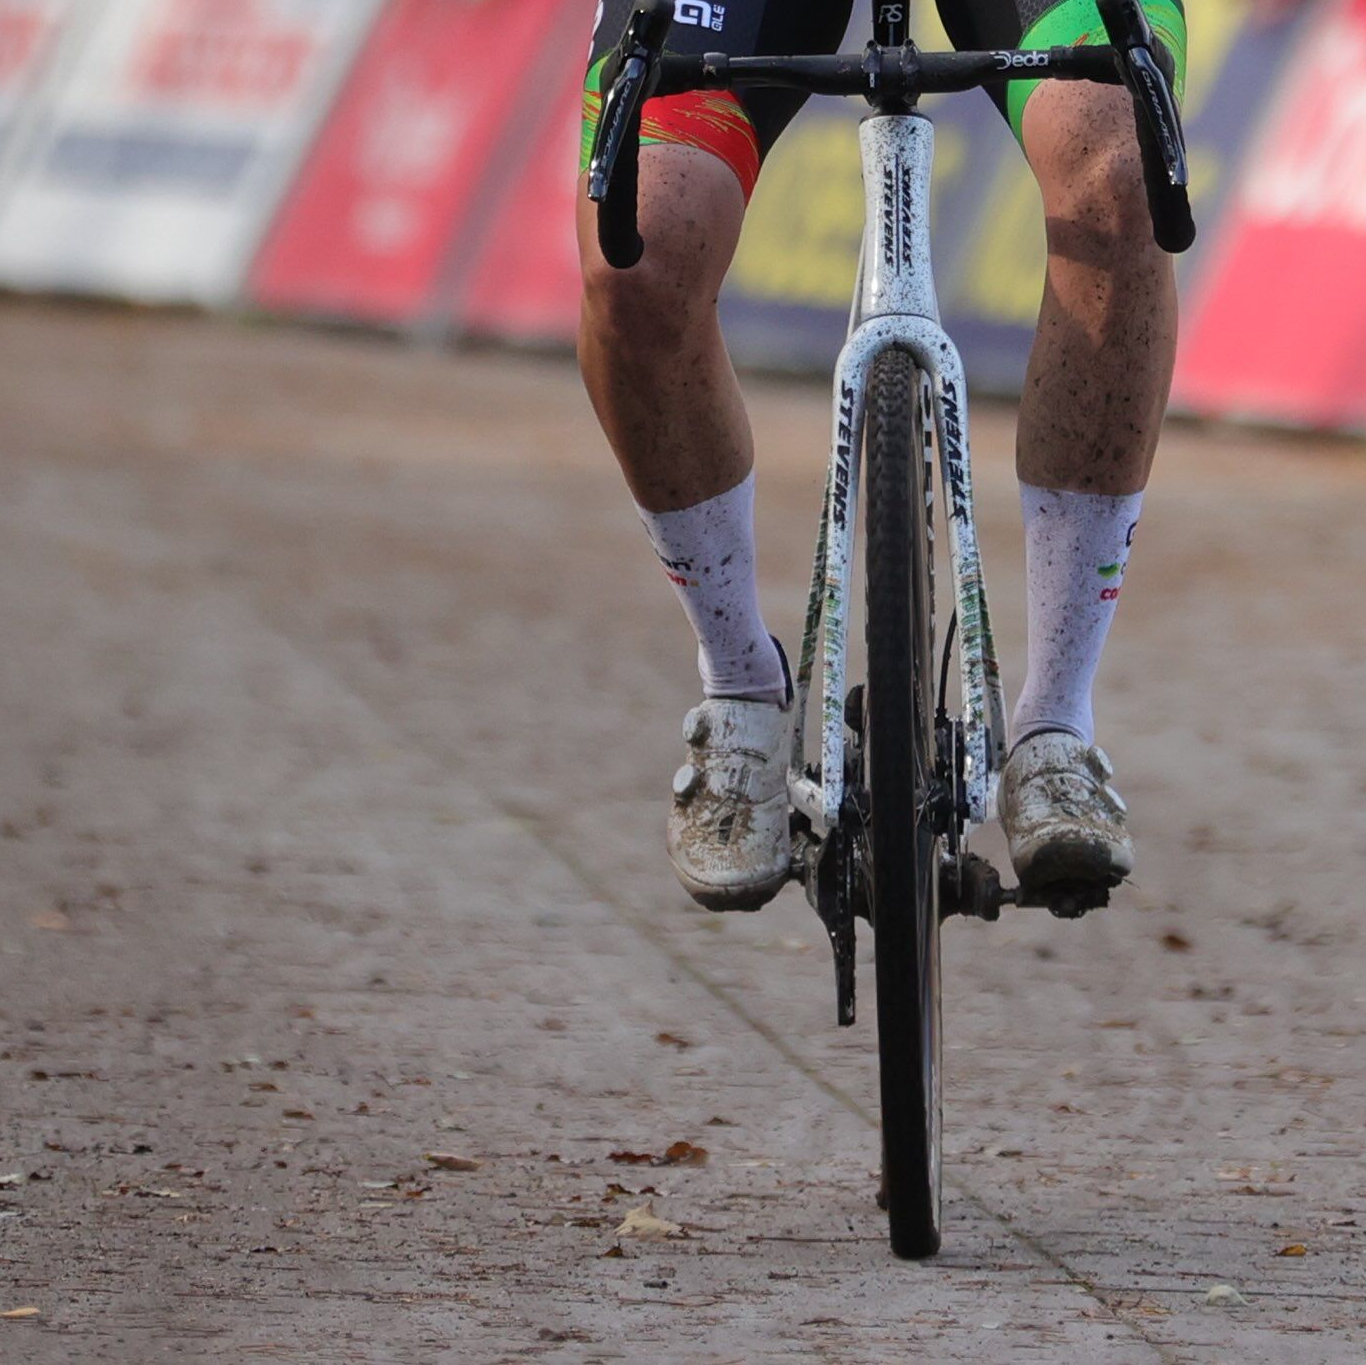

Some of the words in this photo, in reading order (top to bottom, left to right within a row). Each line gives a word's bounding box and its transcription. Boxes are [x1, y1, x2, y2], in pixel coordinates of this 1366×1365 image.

[989, 50, 1050, 71] Deda
[883, 164, 894, 268] STEVENS
[832, 380, 856, 531] STEVENS
[940, 377, 970, 525] STEVENS
